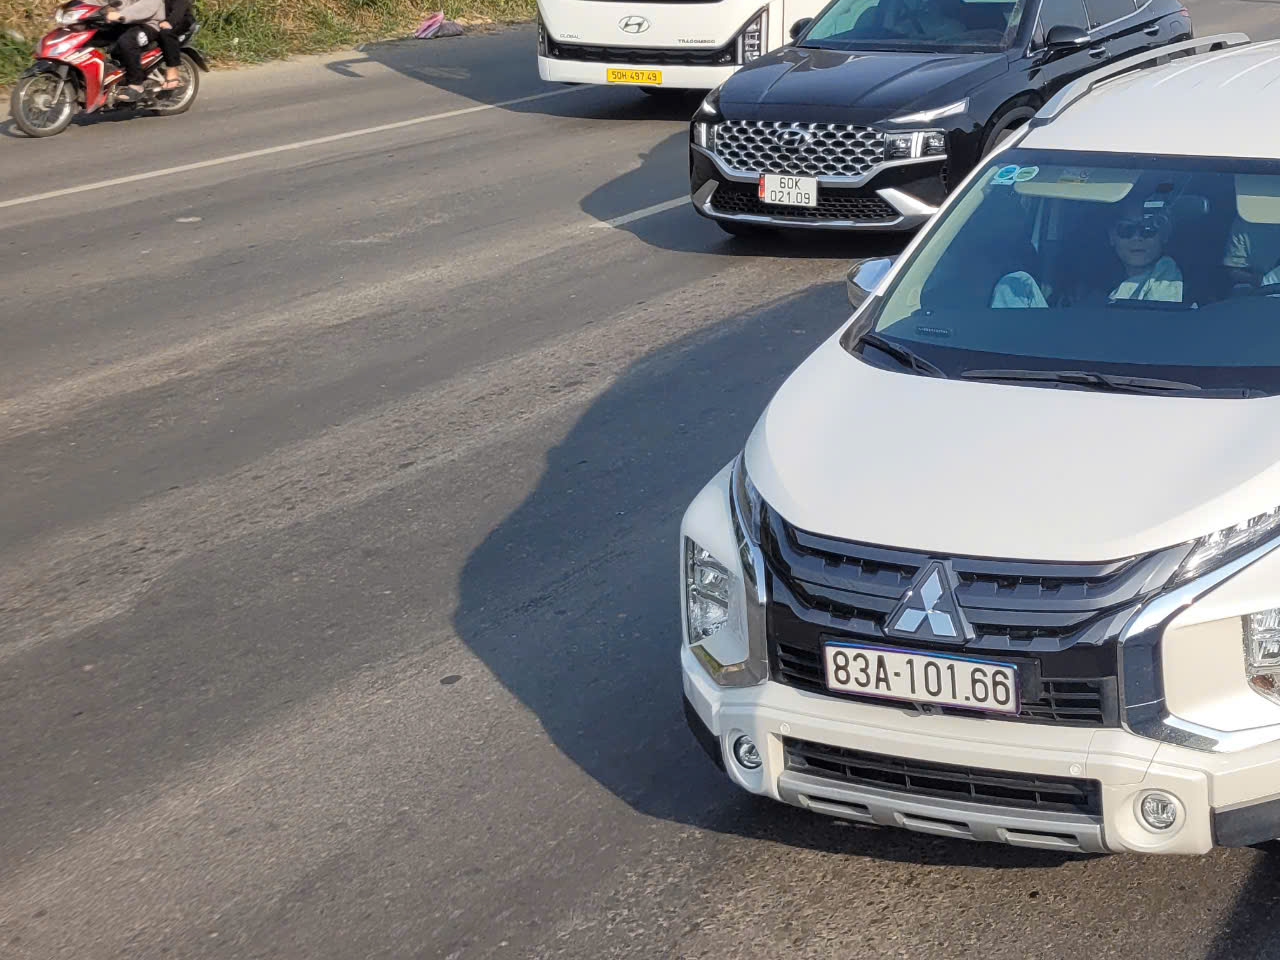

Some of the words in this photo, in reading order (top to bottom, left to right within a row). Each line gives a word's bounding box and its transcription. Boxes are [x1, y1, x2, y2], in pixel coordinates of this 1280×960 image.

[779, 176, 801, 190] 60K
[770, 190, 811, 205] 021.09
[832, 650, 1011, 706] 83A-101.66
